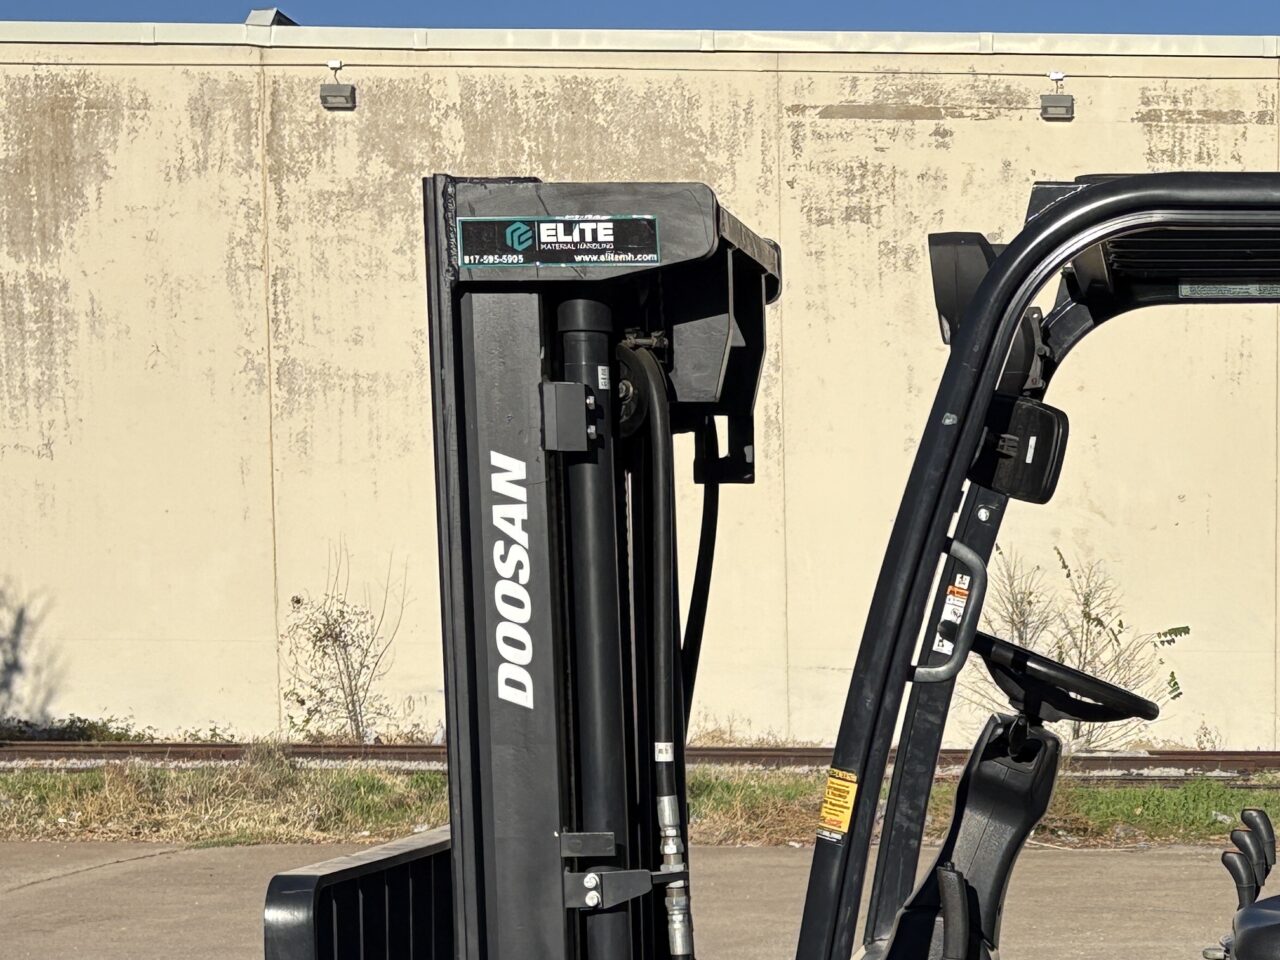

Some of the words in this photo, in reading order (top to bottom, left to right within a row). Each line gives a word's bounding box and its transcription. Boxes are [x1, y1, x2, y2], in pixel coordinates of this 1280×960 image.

[540, 222, 614, 242] ELITE
[574, 253, 657, 263] www.elitemh.com
[490, 450, 534, 709] DOOSAN
